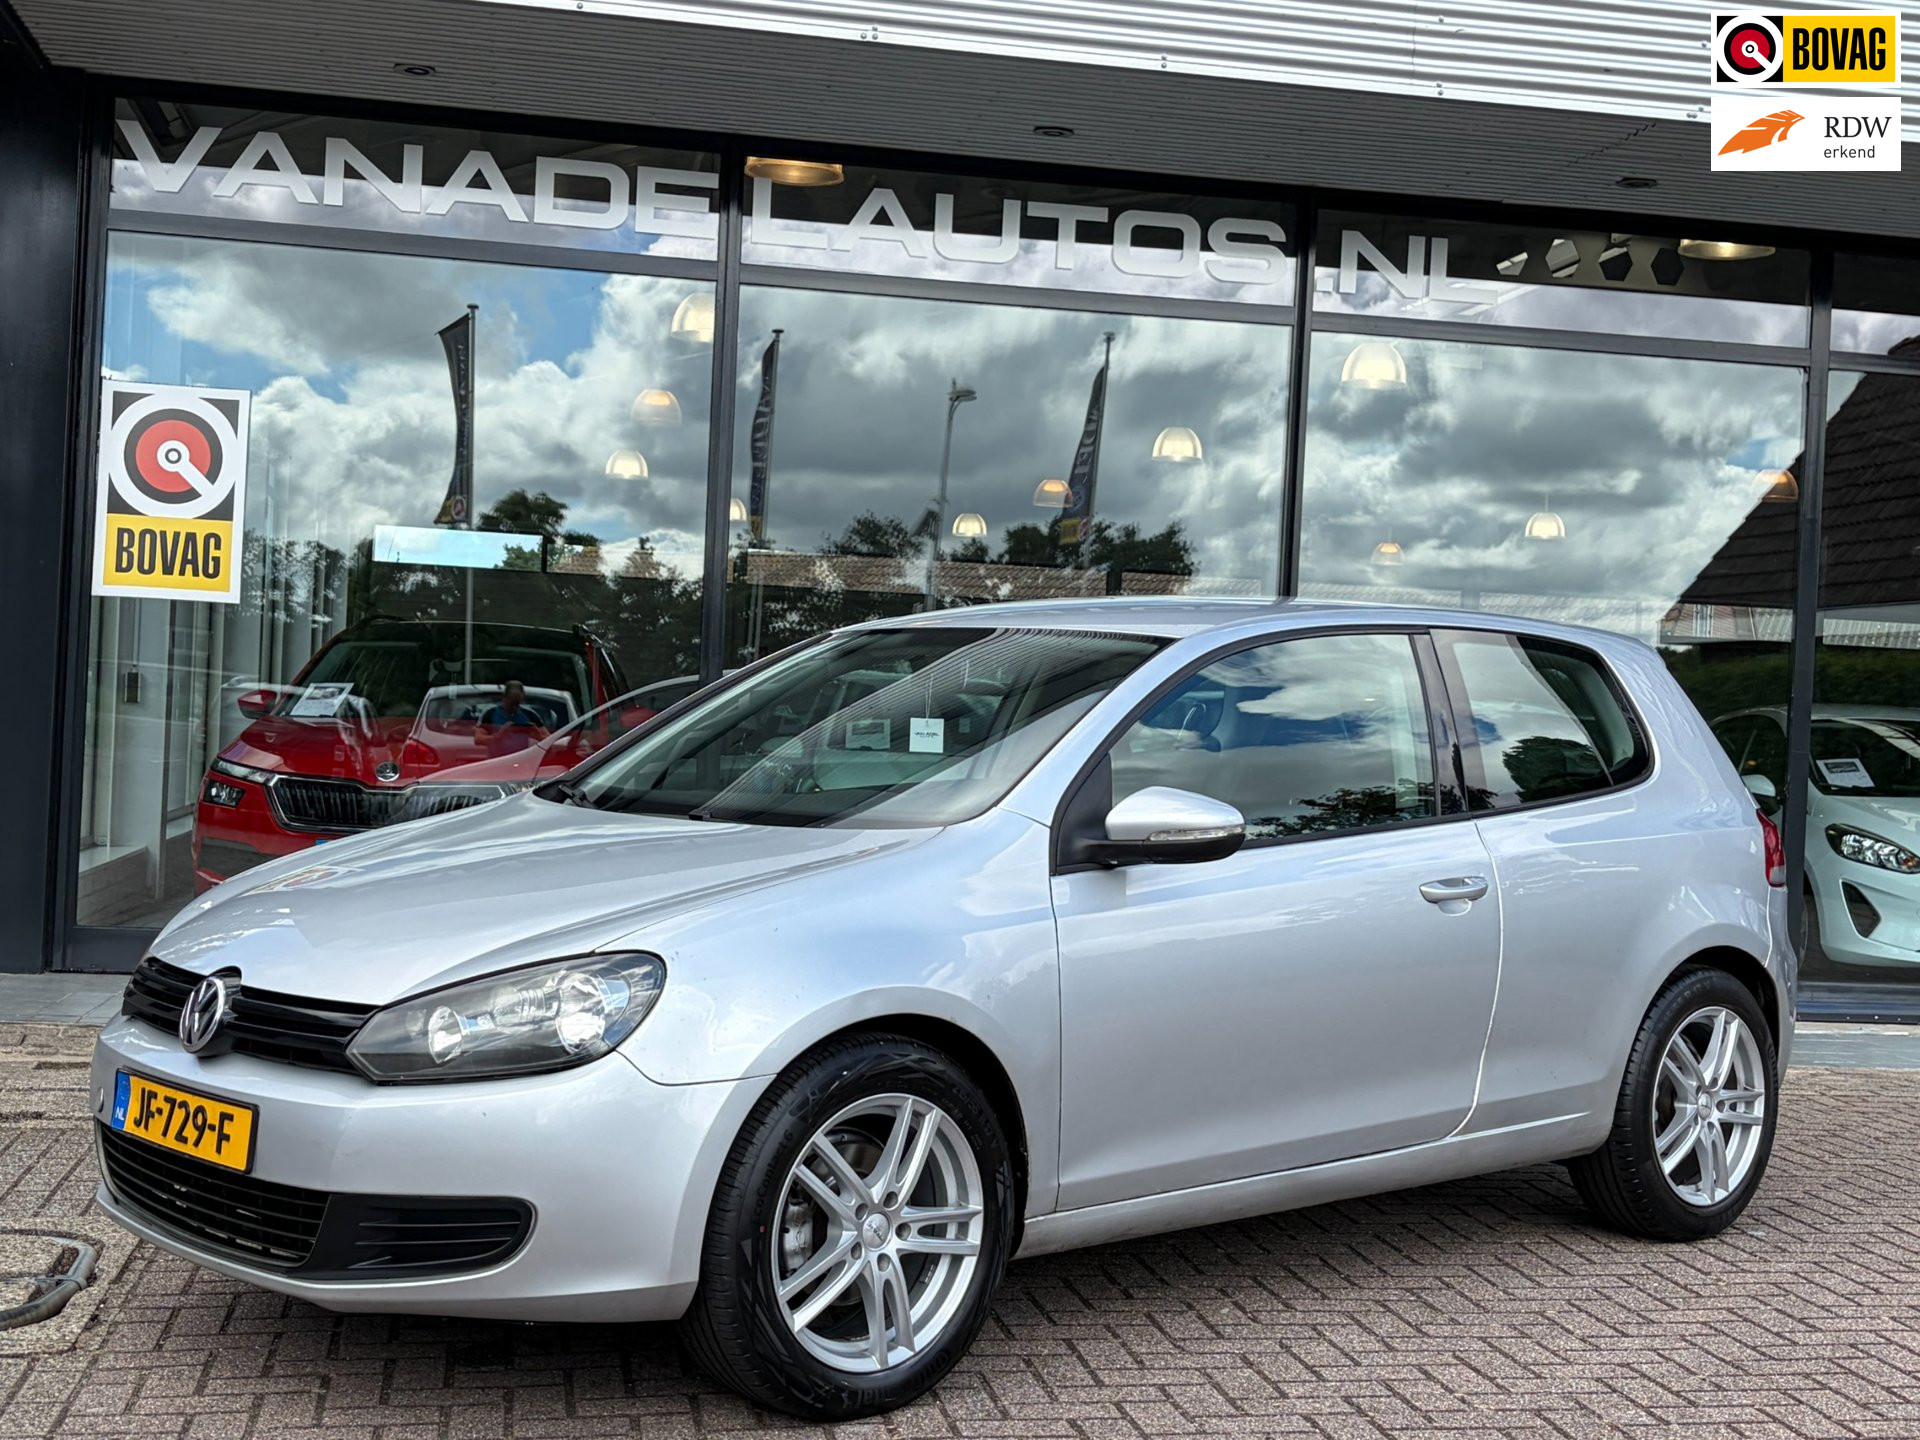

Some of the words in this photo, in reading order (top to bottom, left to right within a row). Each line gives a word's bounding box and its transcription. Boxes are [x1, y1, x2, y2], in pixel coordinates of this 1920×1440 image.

[115, 527, 222, 579] BOVAG
[115, 1106, 125, 1121] NL
[133, 1086, 234, 1155] JF-729-F
